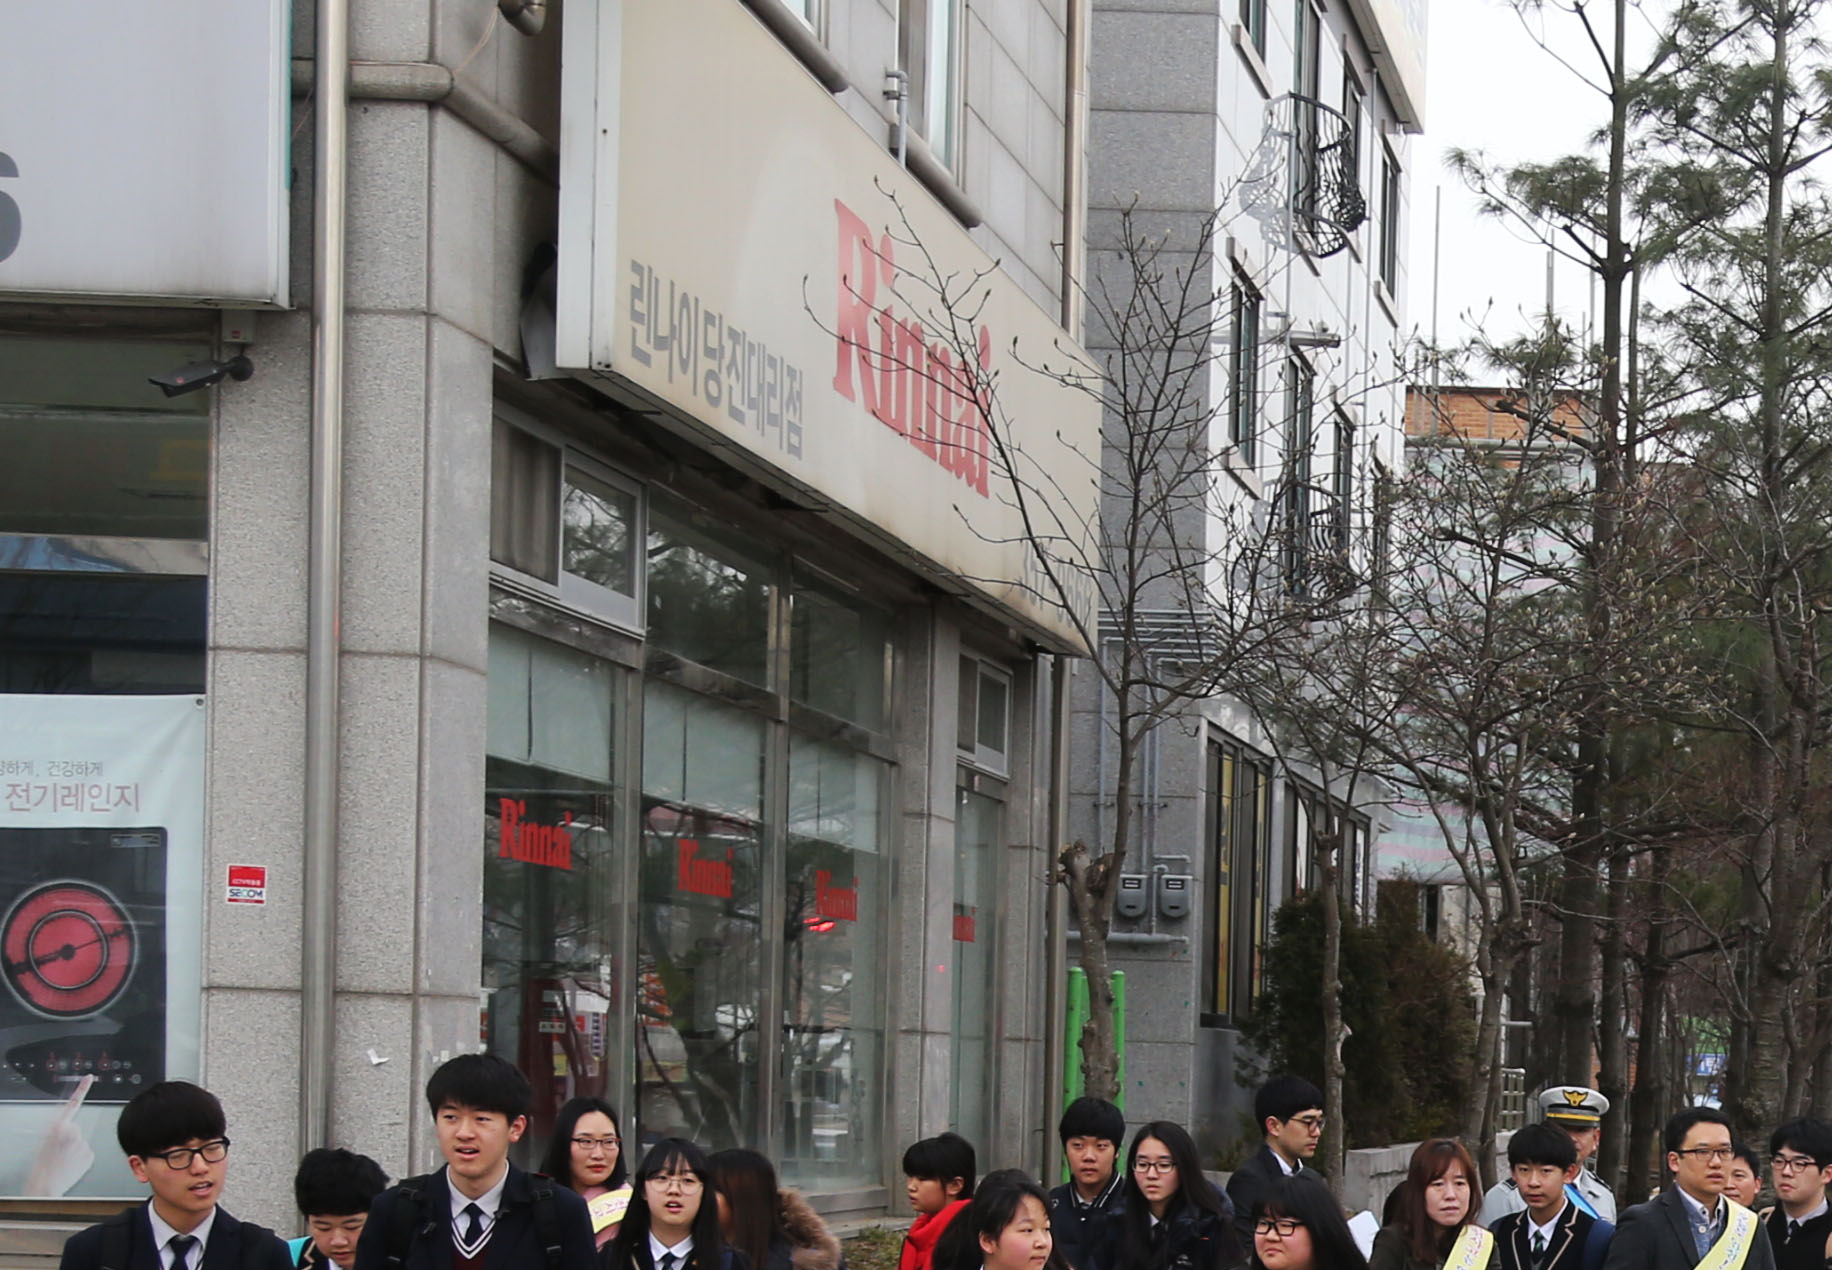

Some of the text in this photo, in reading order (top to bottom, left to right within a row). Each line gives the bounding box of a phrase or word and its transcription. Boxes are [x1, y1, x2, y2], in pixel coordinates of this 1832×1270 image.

[630, 259, 803, 461] 린나이 당진대리점
[834, 198, 989, 498] Rinnai
[5, 782, 140, 812] 전기레인지
[48, 761, 104, 777] 건강하게
[500, 798, 572, 870] Rinnai
[229, 888, 263, 898] SECOM
[678, 838, 733, 898] Rinnai
